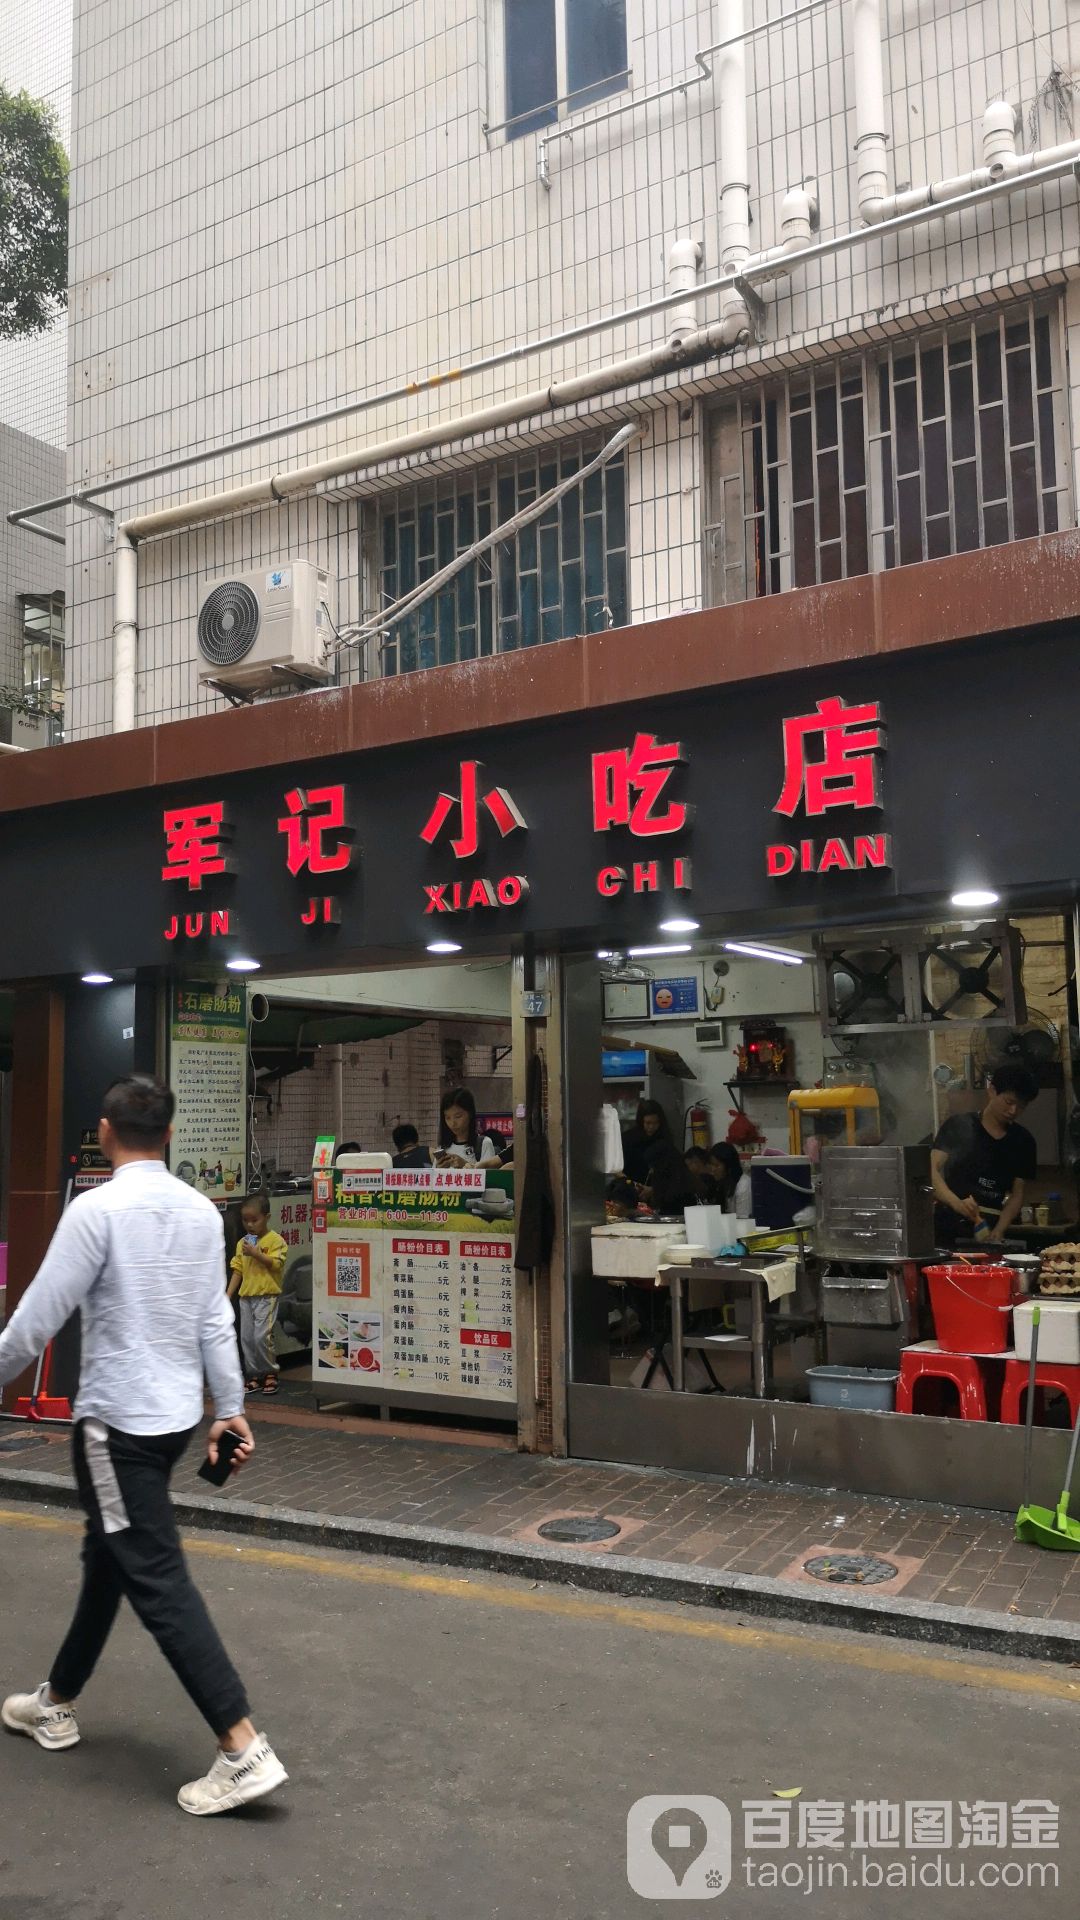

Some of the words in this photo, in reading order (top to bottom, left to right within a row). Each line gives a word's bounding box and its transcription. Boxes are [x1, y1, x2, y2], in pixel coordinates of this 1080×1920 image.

[161, 696, 885, 891] 军记小吃店
[164, 910, 233, 941] JUN
[301, 897, 338, 926] JI
[423, 875, 528, 914] XIAO
[597, 857, 691, 897] CHI
[766, 834, 891, 877] DIAN
[185, 992, 241, 1013] 石磨肠粉
[528, 1002, 542, 1013] 47
[435, 1173, 482, 1187] 点单收银区
[398, 1242, 444, 1254] 肠粉价目表
[464, 1244, 506, 1256] 肠粉价目表
[438, 1261, 449, 1270] 4元
[501, 1264, 511, 1274] 2元
[438, 1277, 449, 1286] 5元
[502, 1278, 512, 1287] 2元
[439, 1293, 450, 1301] 6元
[502, 1290, 512, 1300] 2元
[502, 1303, 512, 1312] 2元
[438, 1308, 450, 1317] 6元
[439, 1324, 450, 1333] 7元
[474, 1333, 499, 1345] 饮品区
[439, 1340, 450, 1349] 8元
[436, 1356, 450, 1365] 10元
[502, 1353, 512, 1362] 2元
[502, 1366, 512, 1375] 3元
[435, 1372, 450, 1381] 10元
[499, 1379, 512, 1388] 25元
